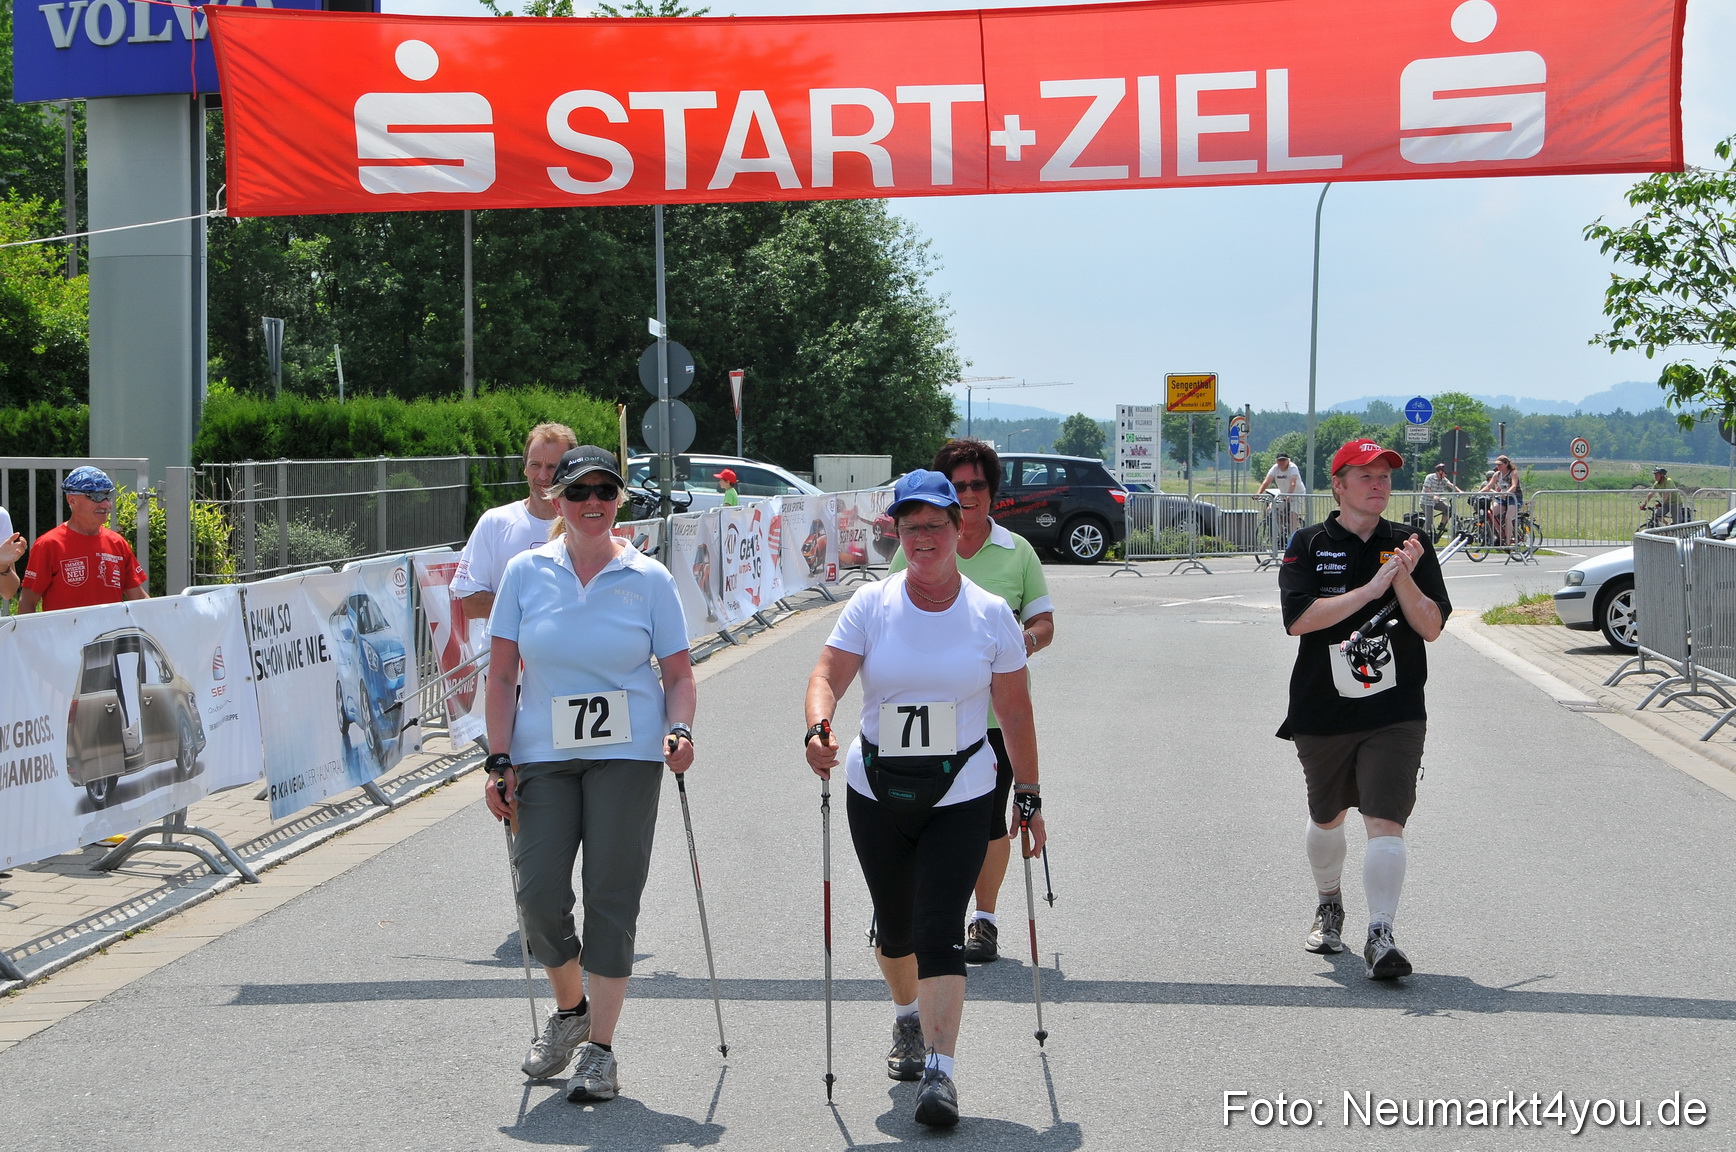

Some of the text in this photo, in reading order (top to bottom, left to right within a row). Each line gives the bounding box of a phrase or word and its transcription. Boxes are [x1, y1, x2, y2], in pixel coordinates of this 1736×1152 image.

[38, 0, 268, 49] VOLV
[1171, 380, 1212, 392] Sengenthal
[1574, 443, 1586, 454] 60
[568, 456, 584, 467] Audi
[1315, 550, 1347, 559] Cellagon
[67, 569, 85, 578] NEU
[1323, 563, 1347, 571] killtec
[278, 603, 292, 634] SO
[284, 638, 304, 671] WIE
[305, 633, 332, 665] NIE.
[568, 695, 611, 740] 72
[897, 705, 930, 748] 71
[13, 714, 55, 748] GROSS.
[1023, 794, 1032, 817] LEKI
